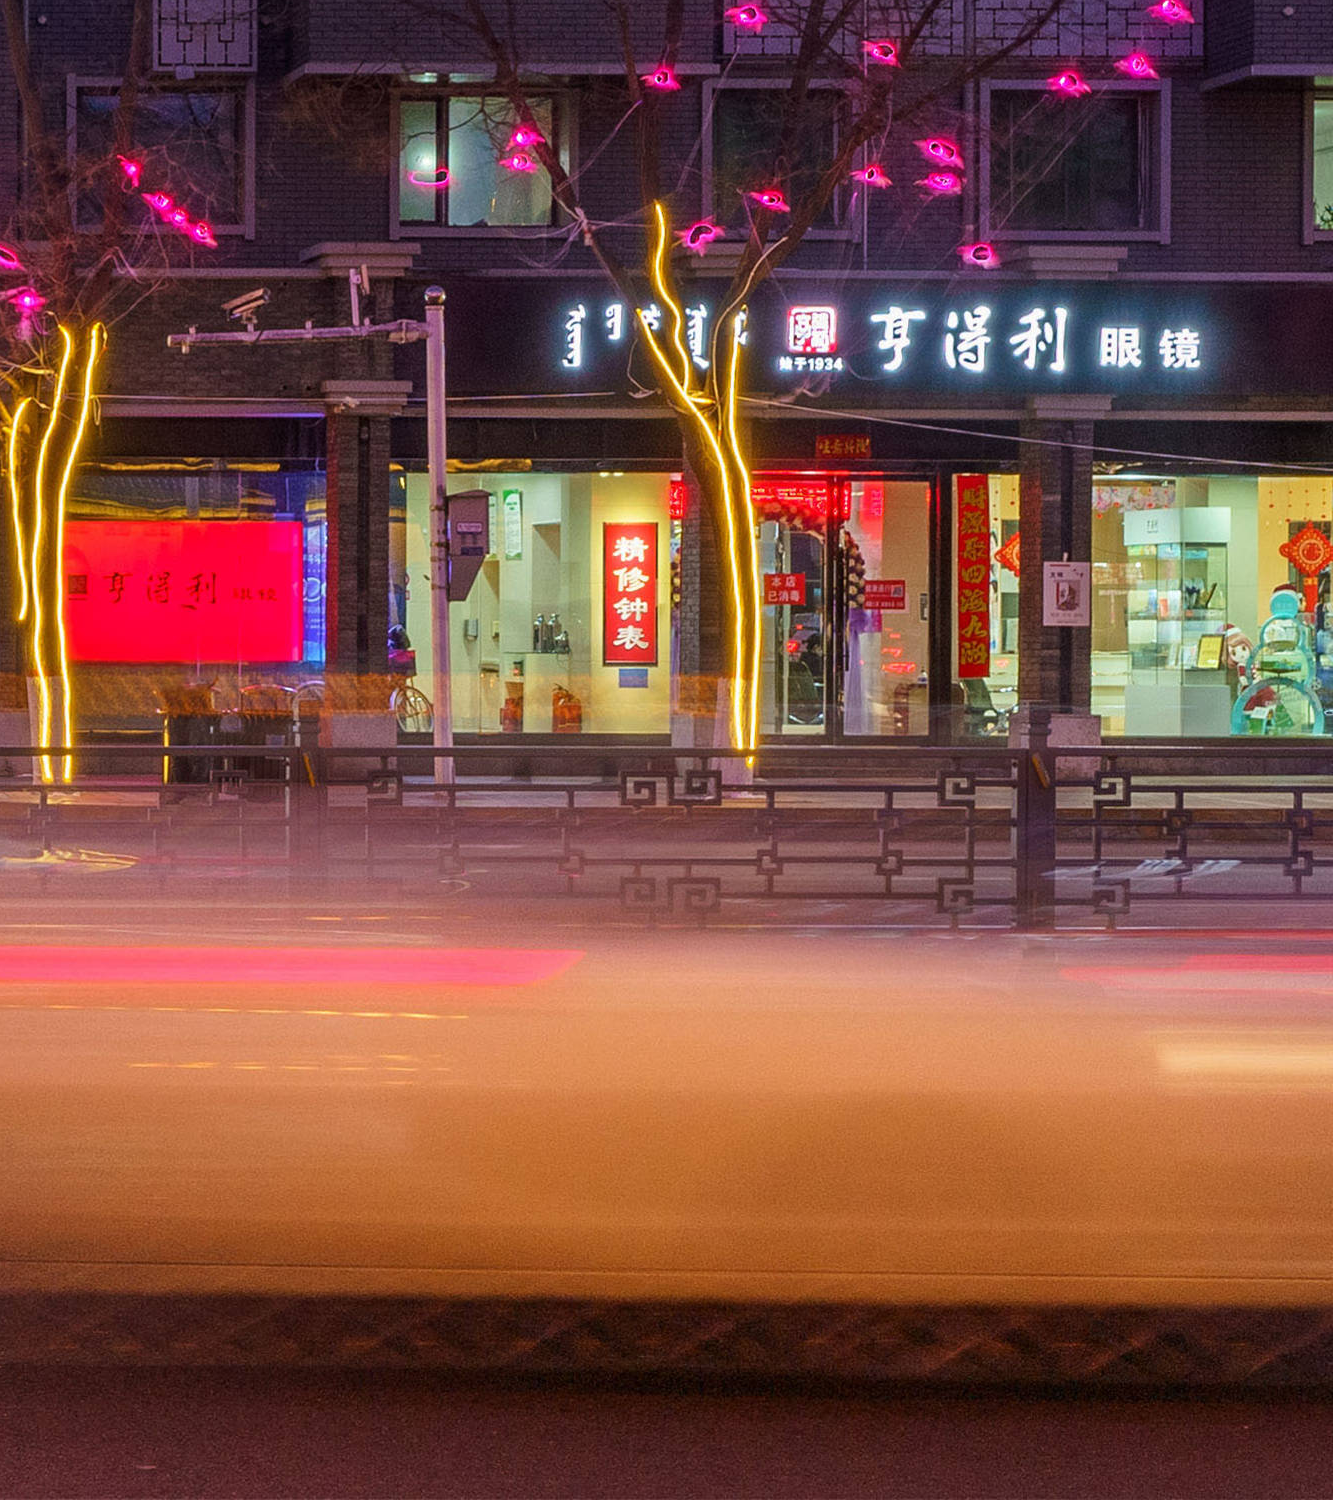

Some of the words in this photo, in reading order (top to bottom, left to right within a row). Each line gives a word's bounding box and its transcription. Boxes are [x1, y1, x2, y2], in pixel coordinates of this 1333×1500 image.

[1099, 326, 1201, 368] 眼镜
[612, 536, 650, 651] 精修钟表
